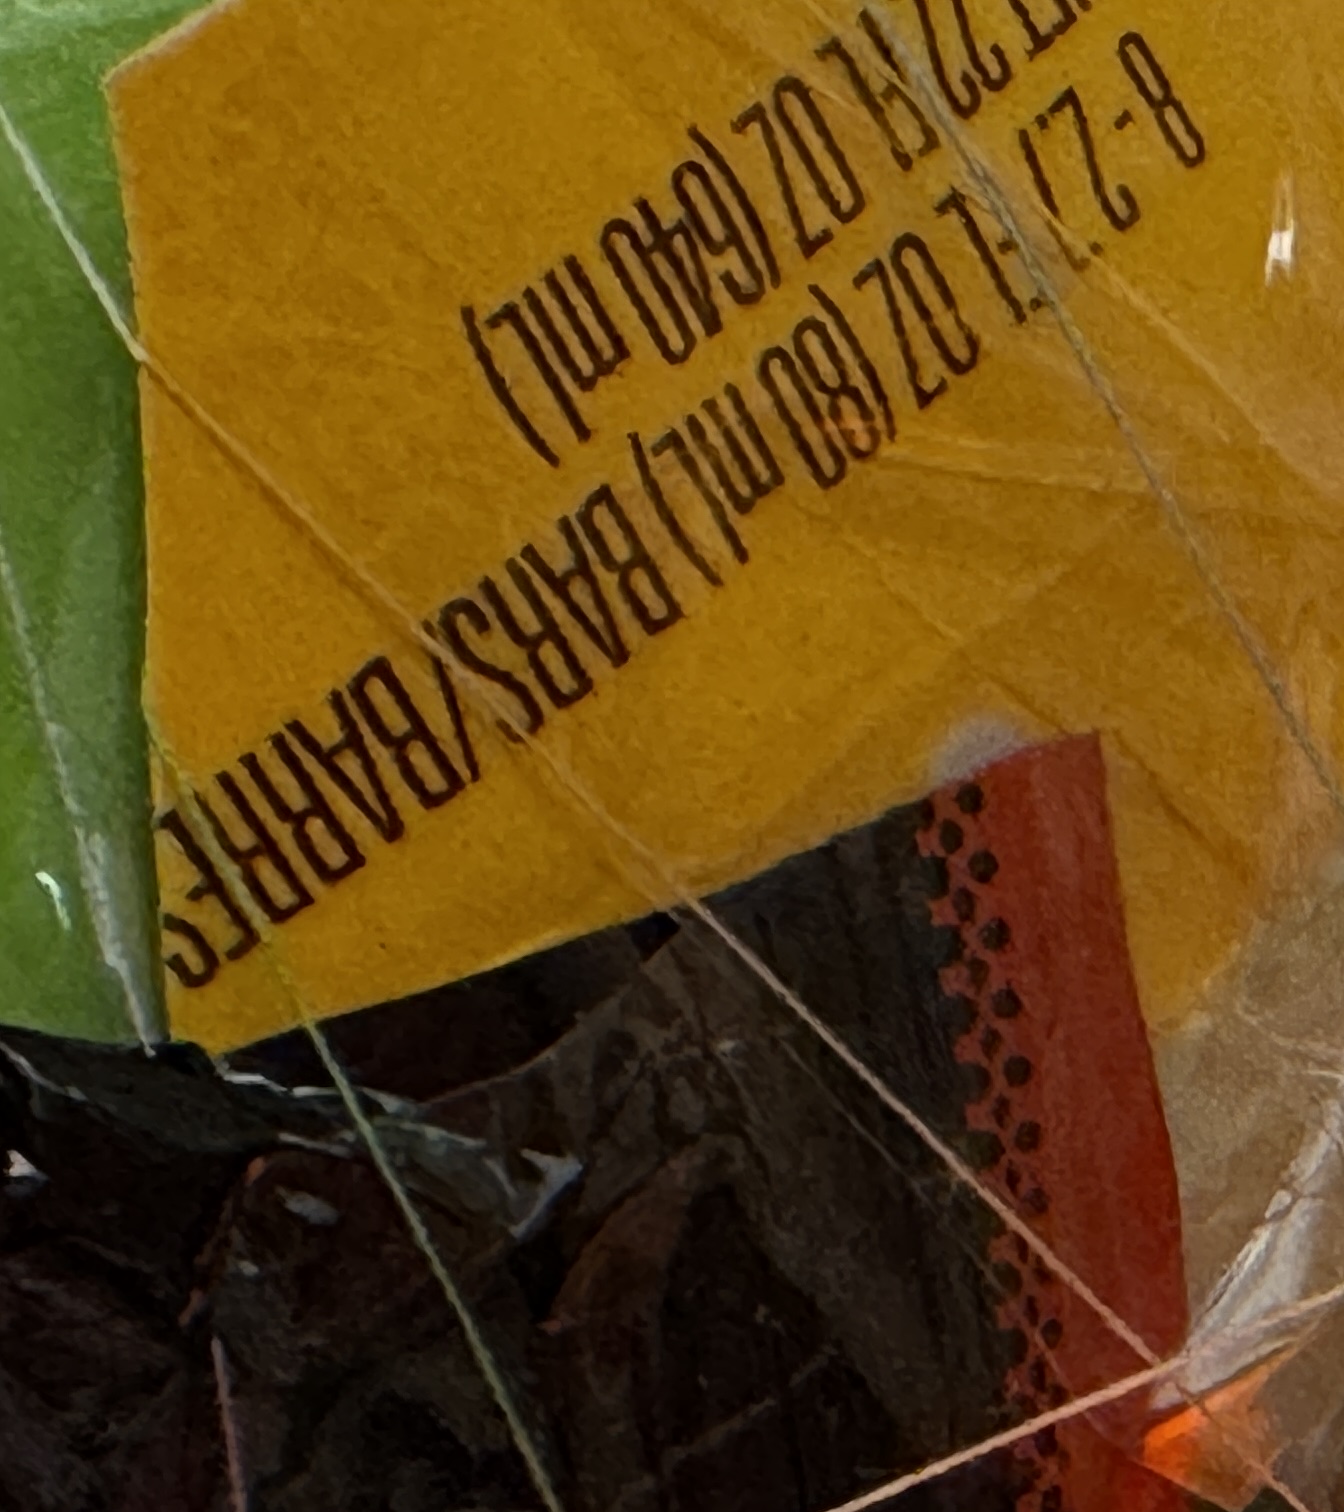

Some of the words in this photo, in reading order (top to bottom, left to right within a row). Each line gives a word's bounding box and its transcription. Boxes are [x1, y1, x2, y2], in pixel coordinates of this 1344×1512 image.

[600, 122, 782, 366] (640
[730, 75, 866, 260] OZ
[460, 303, 631, 470] mL)
[757, 283, 897, 490] (80
[852, 232, 980, 410] OZ
[627, 428, 786, 588] mL)
